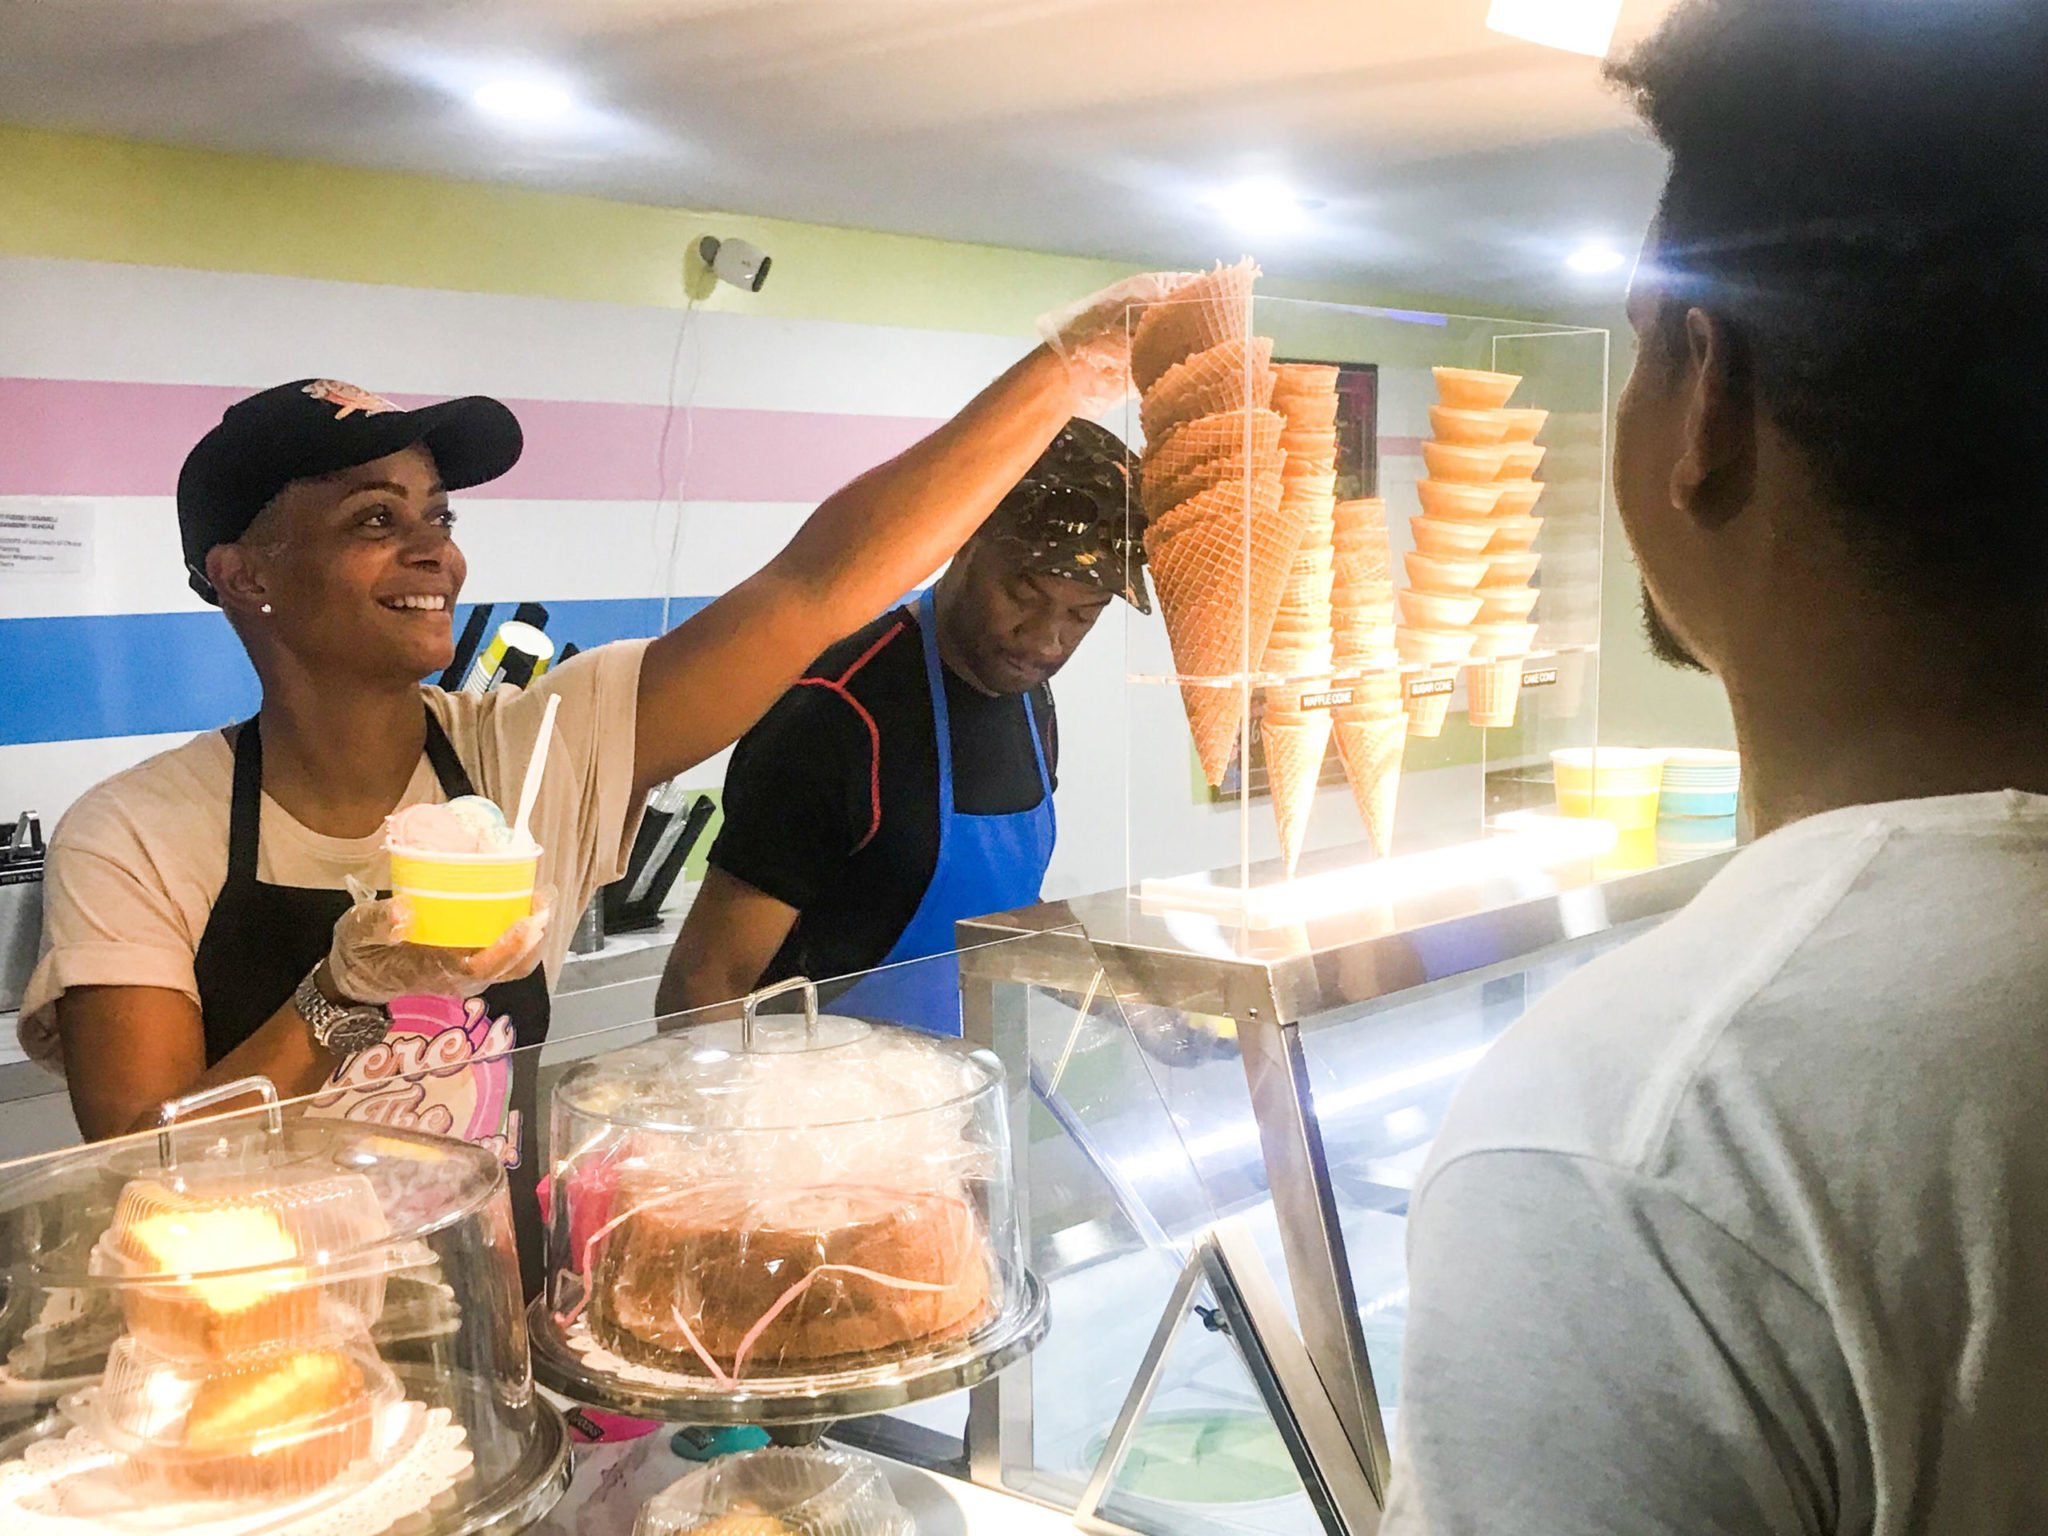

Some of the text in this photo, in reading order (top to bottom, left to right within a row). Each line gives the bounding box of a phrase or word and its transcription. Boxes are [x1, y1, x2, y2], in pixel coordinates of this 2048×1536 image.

[1540, 671, 1556, 682] CONE
[1434, 680, 1452, 691] CONE
[1303, 691, 1352, 707] WAFFLE CONE
